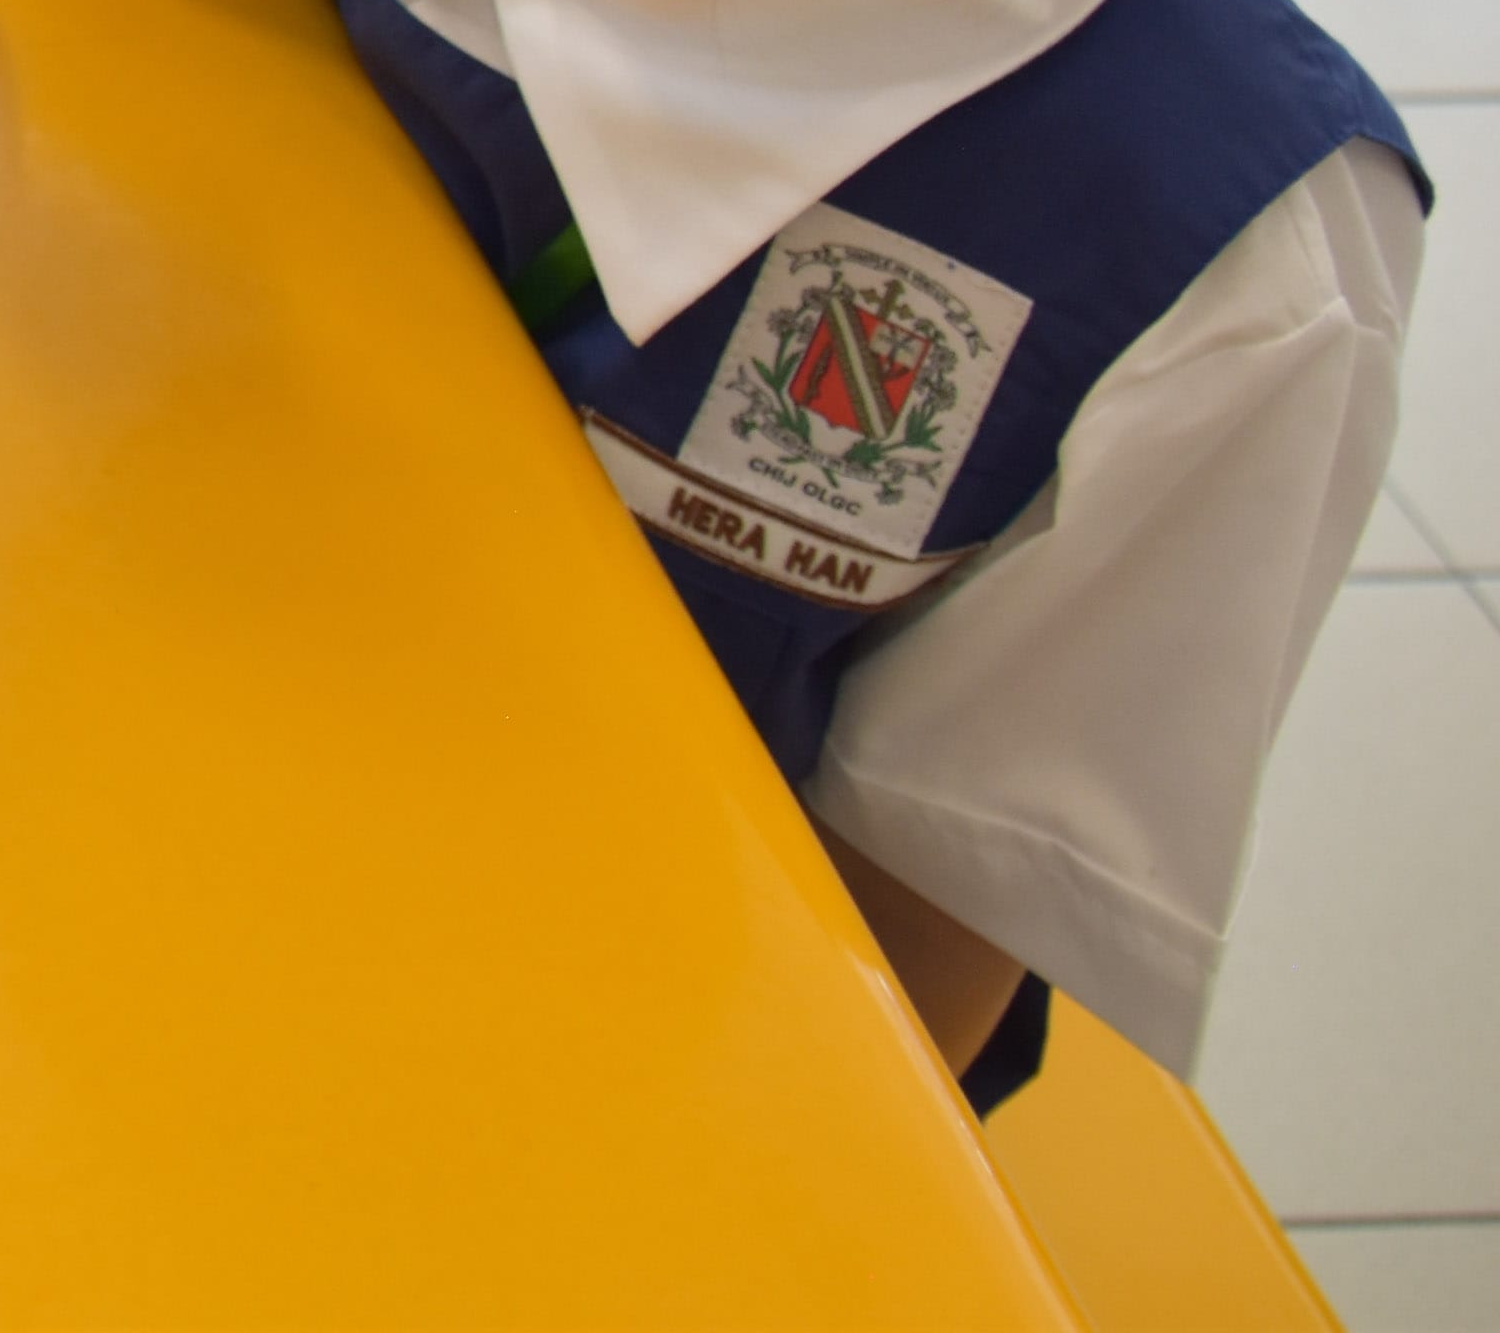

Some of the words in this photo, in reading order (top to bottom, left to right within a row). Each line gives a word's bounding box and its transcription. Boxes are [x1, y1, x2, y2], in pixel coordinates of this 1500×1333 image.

[748, 457, 798, 488] CHIJ
[802, 482, 863, 517] OLGC
[667, 486, 767, 561] HERA
[784, 540, 874, 595] HAN
